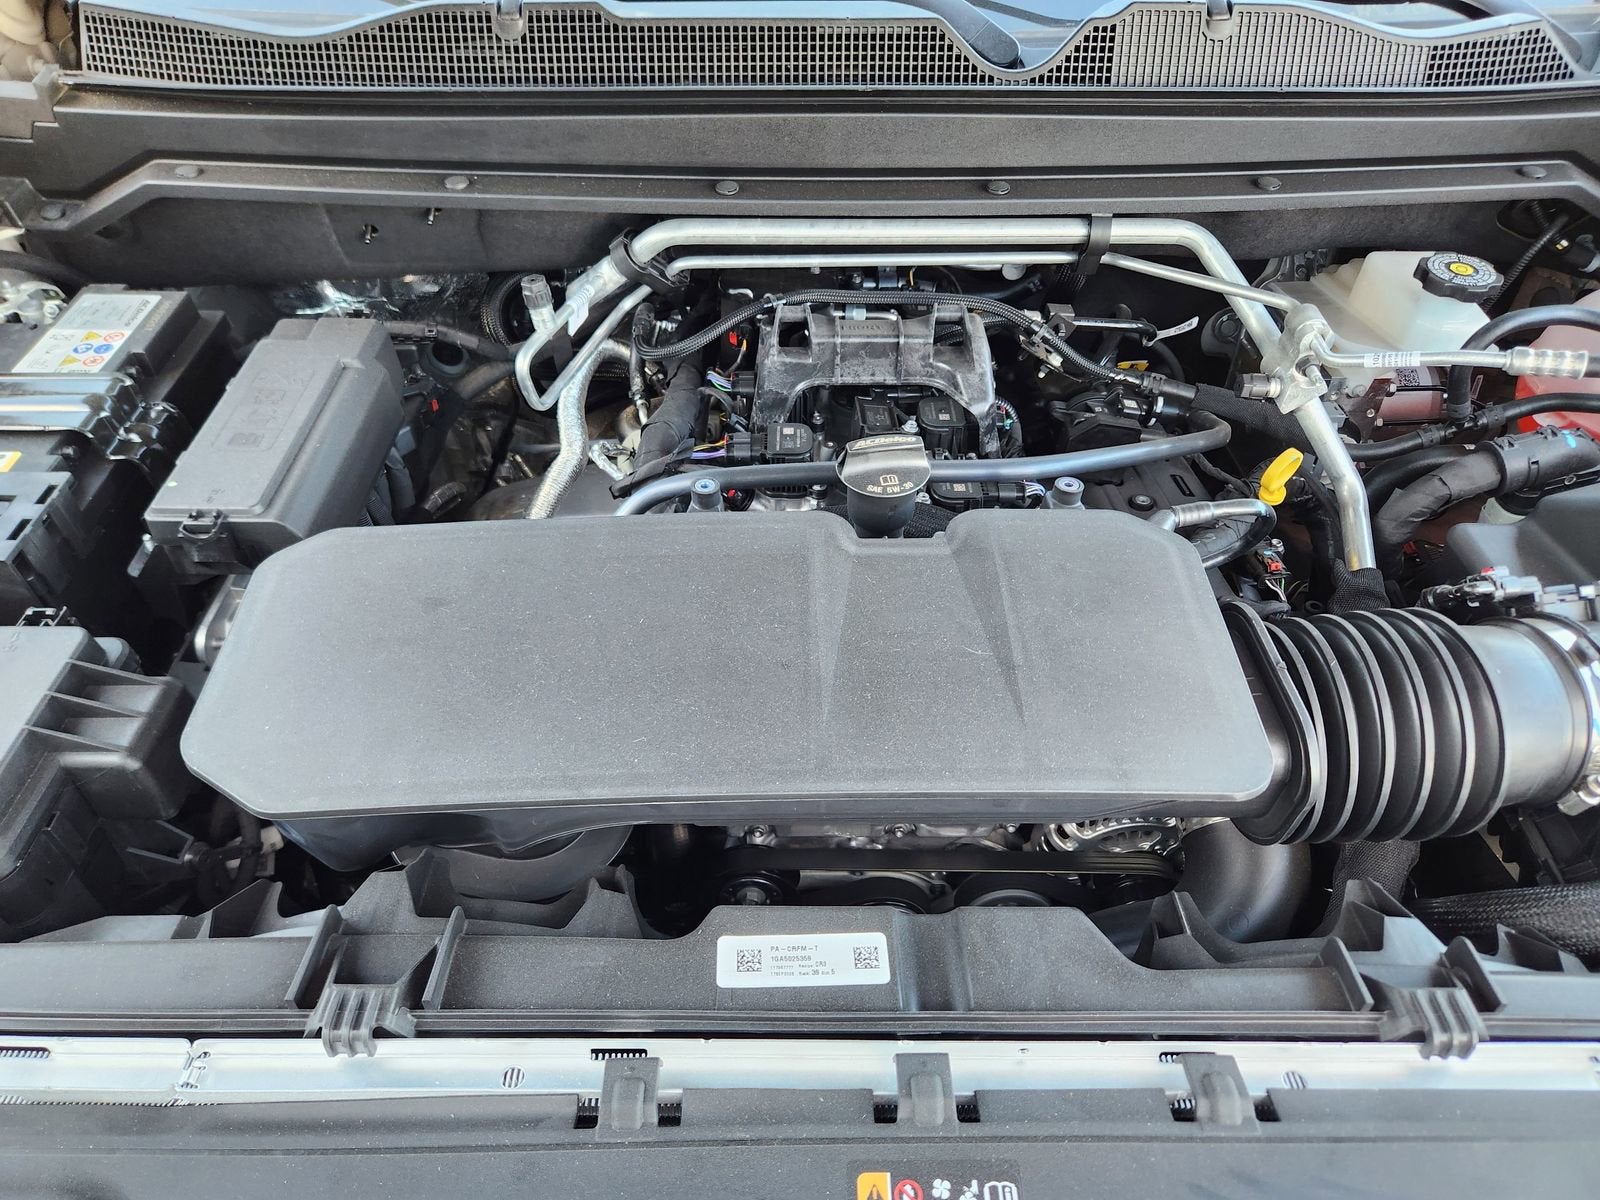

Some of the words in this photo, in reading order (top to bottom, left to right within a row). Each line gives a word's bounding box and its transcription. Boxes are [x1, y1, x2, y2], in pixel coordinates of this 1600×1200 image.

[851, 436, 917, 450] ACDelco
[866, 484, 883, 493] SAE
[886, 481, 914, 493] 5W-30
